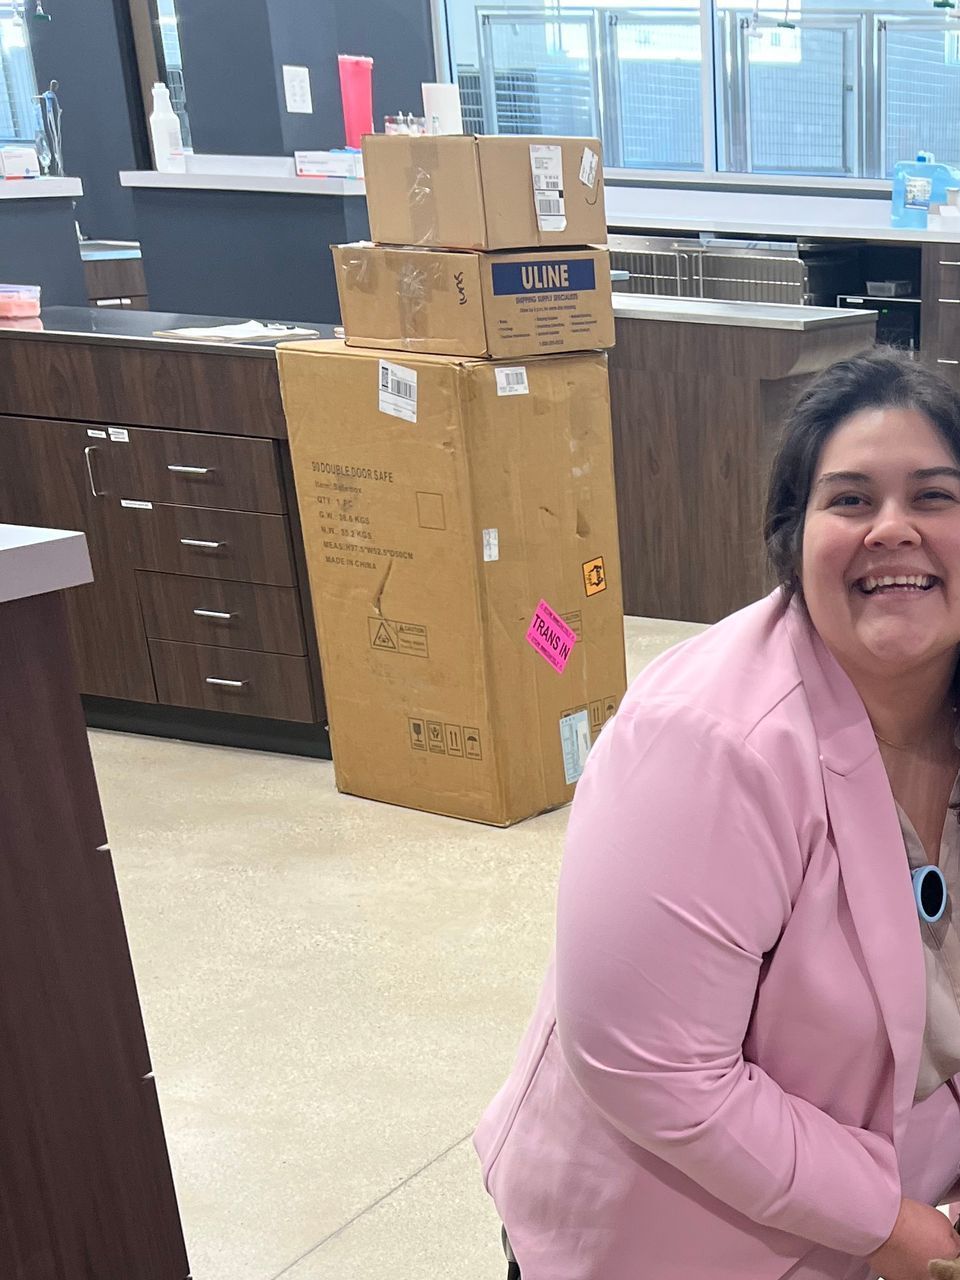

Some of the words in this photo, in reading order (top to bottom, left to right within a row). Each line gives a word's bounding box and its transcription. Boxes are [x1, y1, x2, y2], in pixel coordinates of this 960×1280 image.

[521, 264, 569, 289] ULINE
[351, 467, 373, 480] DOOR
[373, 469, 394, 483] SAFE
[325, 555, 346, 566] MADE
[347, 558, 354, 567] IN
[354, 559, 377, 570] CHINA
[532, 613, 561, 651] TRANS
[559, 642, 570, 661] IN
